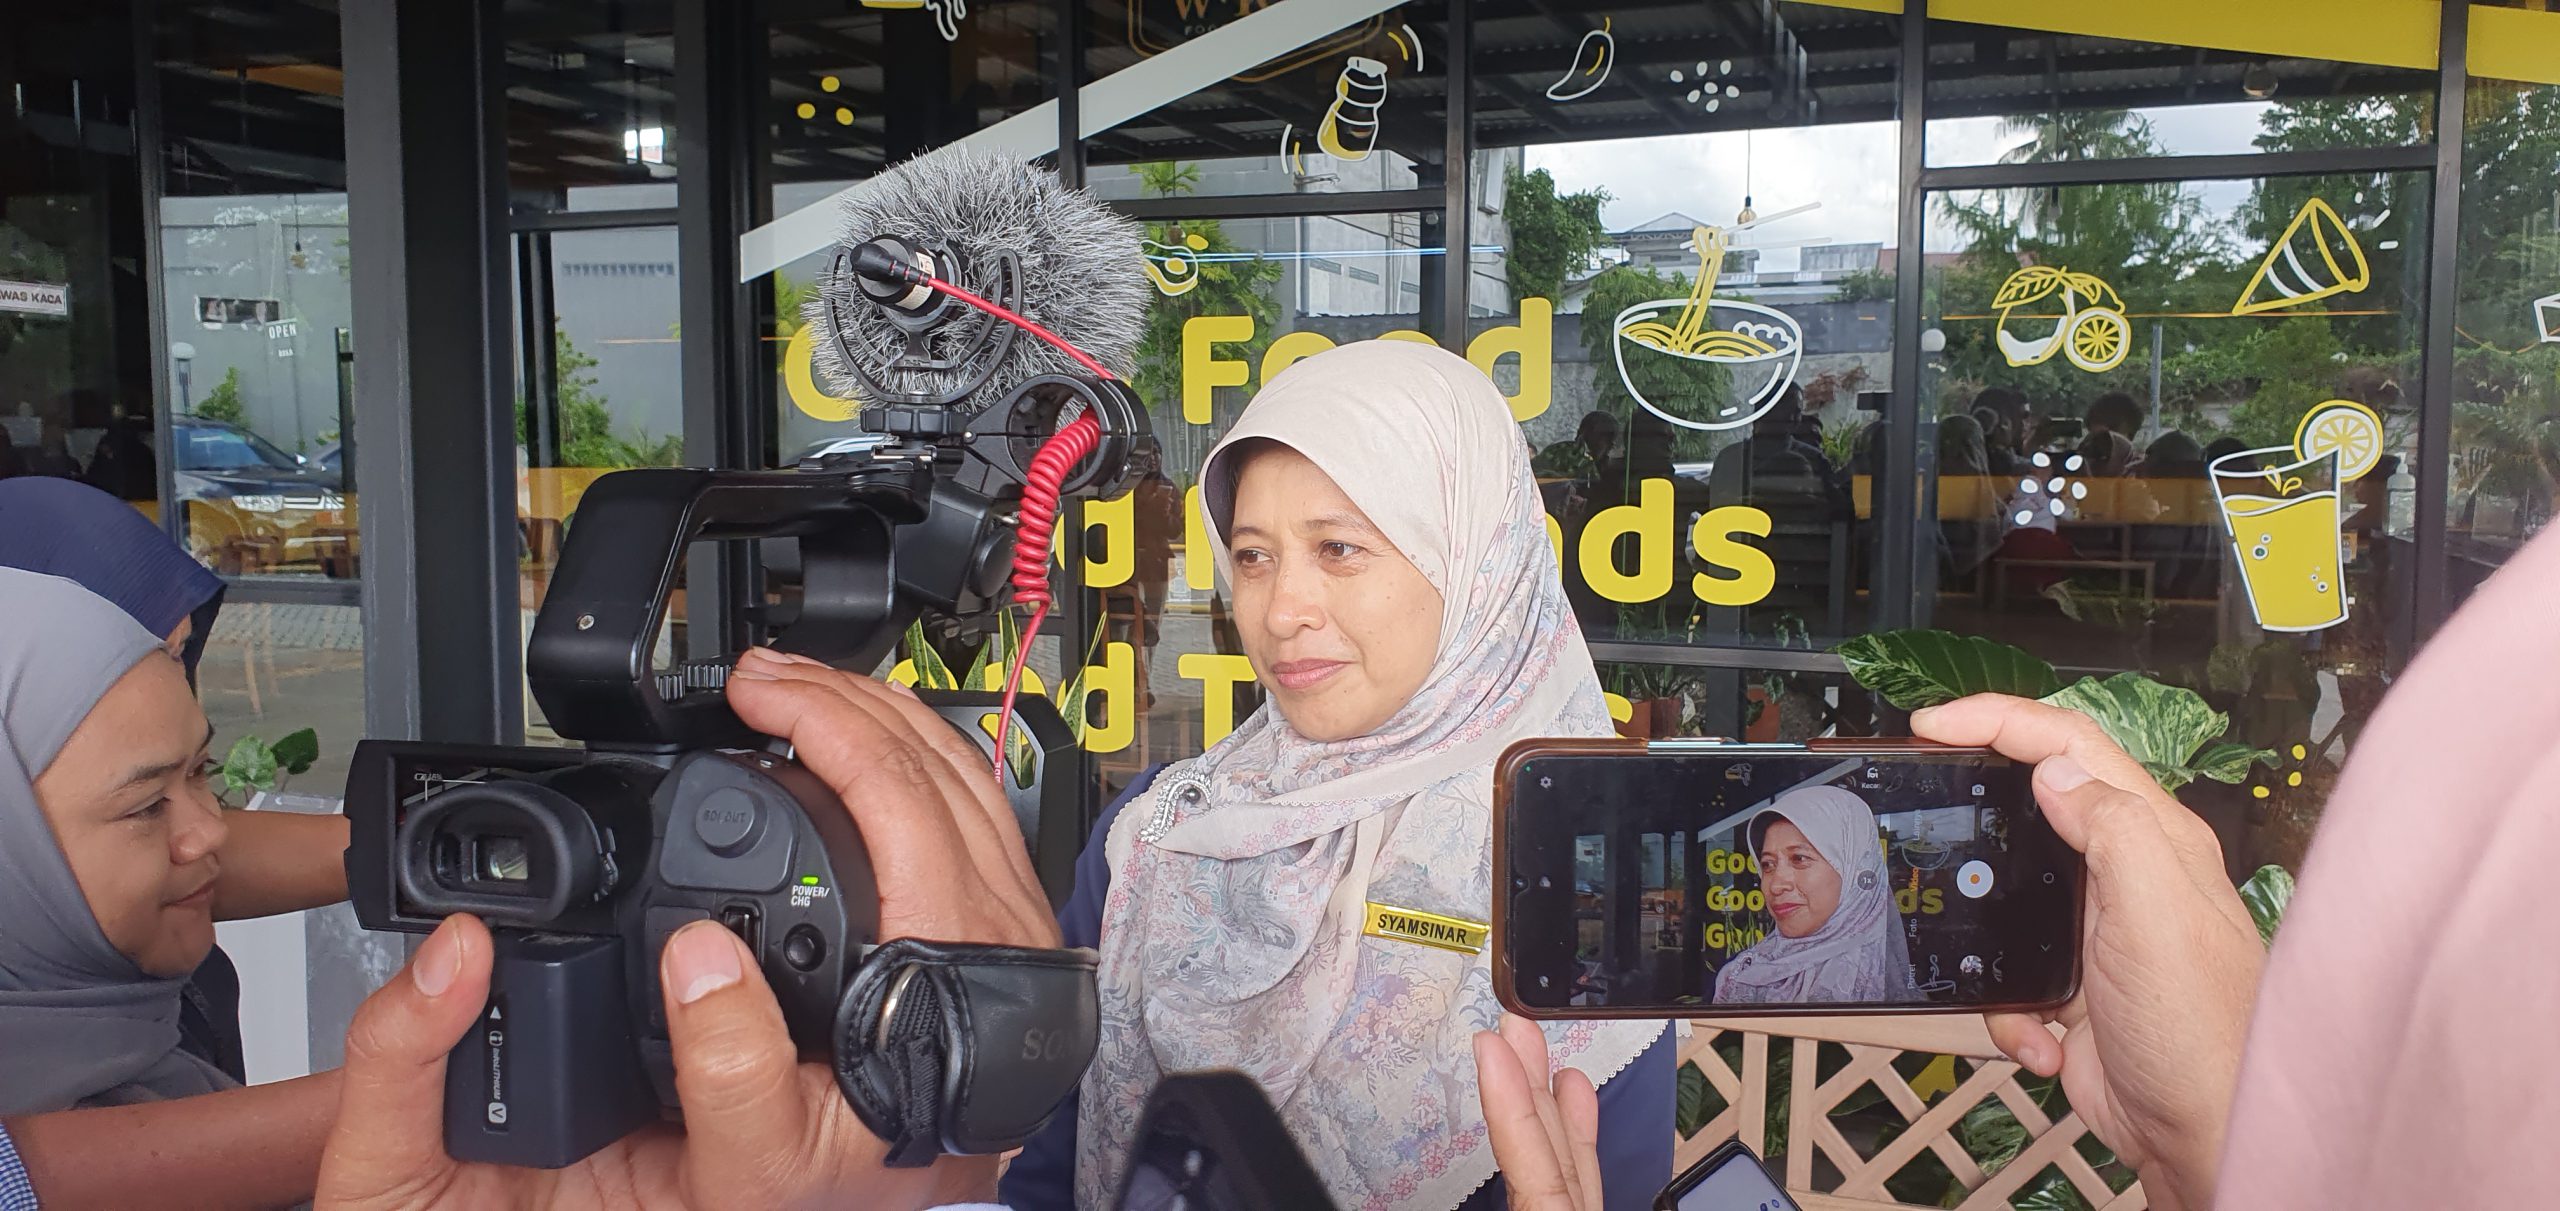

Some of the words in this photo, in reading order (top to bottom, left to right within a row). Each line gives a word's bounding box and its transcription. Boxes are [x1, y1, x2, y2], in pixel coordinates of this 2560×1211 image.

[0, 290, 28, 302] WAS
[31, 292, 63, 305] KACA
[268, 323, 297, 340] OPEN
[1909, 867, 1920, 892] Video
[791, 885, 830, 898] POWER/
[1706, 885, 1765, 912] Goo
[790, 896, 811, 907] CHG
[1377, 913, 1467, 944] SYAMSINAR
[1908, 918, 1917, 938] Foto
